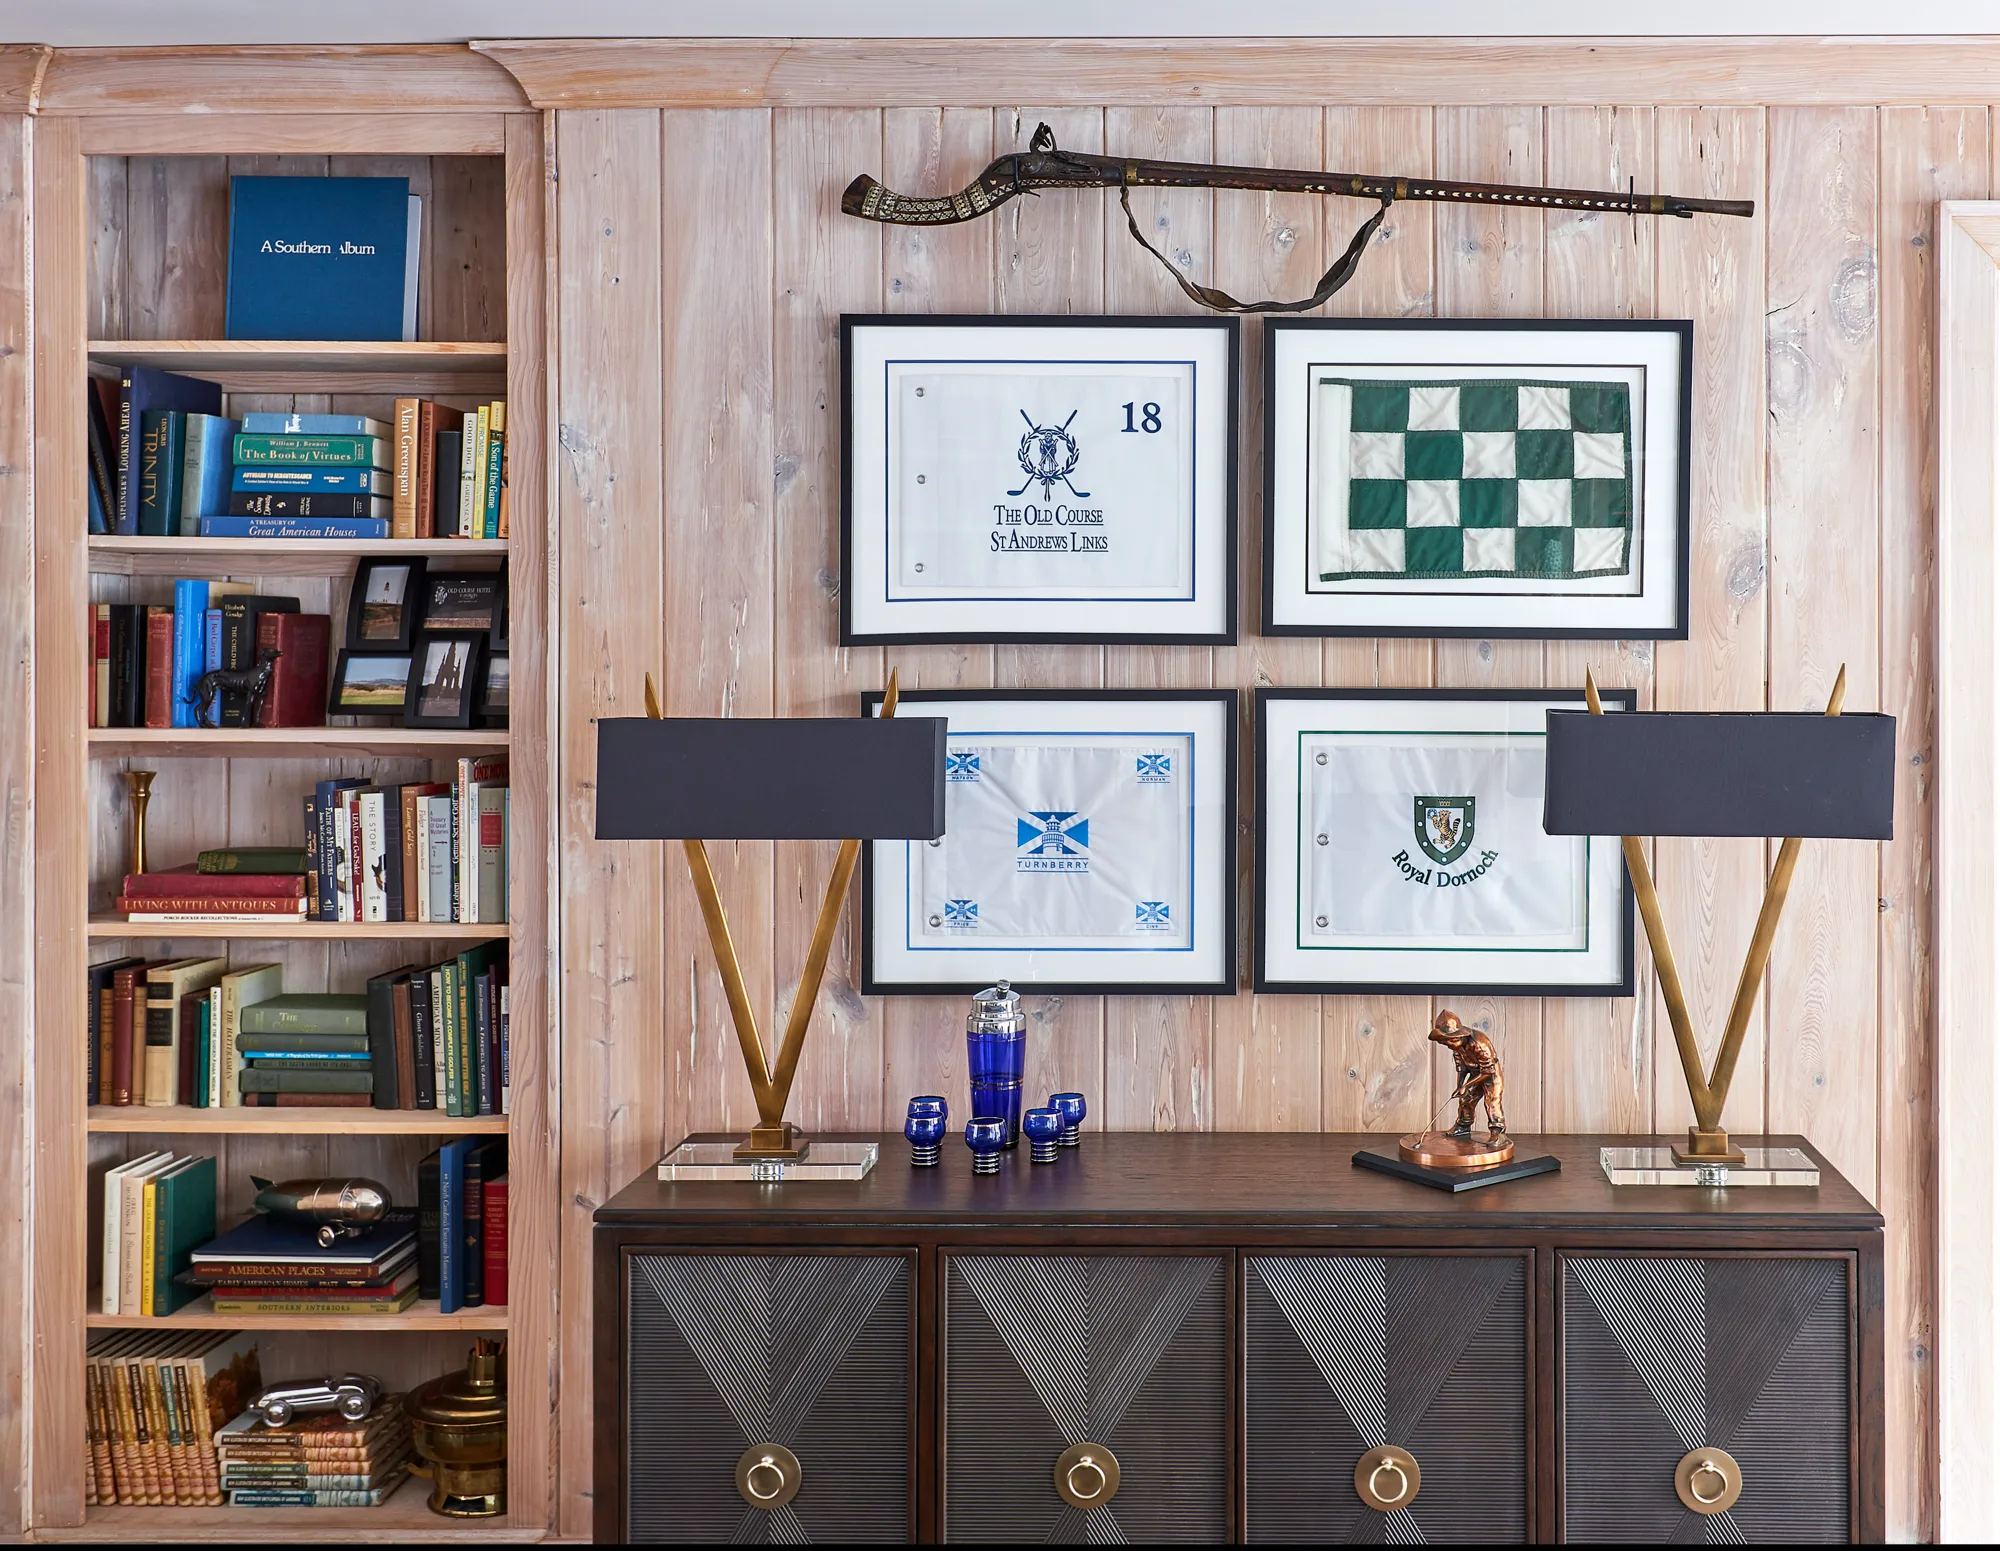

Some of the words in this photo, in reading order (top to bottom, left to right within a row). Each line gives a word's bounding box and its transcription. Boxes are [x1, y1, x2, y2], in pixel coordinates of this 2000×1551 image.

[261, 240, 273, 253] A
[274, 240, 331, 254] Southern
[119, 401, 131, 432] AHEAD
[401, 404, 414, 433] Alan
[1121, 401, 1162, 433] 18
[296, 440, 303, 448] J.
[303, 440, 329, 448] Bennett
[478, 426, 486, 458] PROMISE
[119, 434, 129, 472] LOOKING
[243, 449, 266, 459] The
[269, 449, 298, 460] Book
[300, 450, 310, 461] of
[312, 449, 351, 461] Virtues
[465, 446, 473, 465] DOG
[491, 447, 500, 462] Son
[141, 427, 159, 507] TRINITY
[397, 435, 414, 496] Greenspan
[489, 471, 499, 485] the
[246, 500, 254, 511] The
[488, 486, 498, 509] Game
[248, 525, 275, 537] Great
[279, 526, 322, 537] American
[325, 526, 357, 538] Houses
[473, 765, 489, 781] ONE
[368, 801, 376, 819] THE
[451, 799, 459, 814] Golf
[325, 807, 333, 826] FAITH
[326, 827, 332, 836] OF
[368, 821, 377, 852] STORY
[326, 836, 334, 848] MY
[1017, 860, 1089, 870] TURNBERRY
[1391, 849, 1432, 886] Royal
[1436, 849, 1499, 888] Dornoch
[124, 900, 168, 910] LIVING
[171, 900, 208, 910] WITH
[211, 900, 276, 911] ANTIQUES
[446, 985, 451, 995] TO
[432, 984, 441, 1024] AMERICAN
[226, 1009, 234, 1024] THE
[279, 1012, 299, 1021] THE
[226, 1027, 234, 1081] HATTERASMAN
[442, 1181, 450, 1199] North
[228, 1266, 285, 1275] AMERICAN
[288, 1266, 325, 1276] PLACES
[442, 1254, 450, 1281] Mansion
